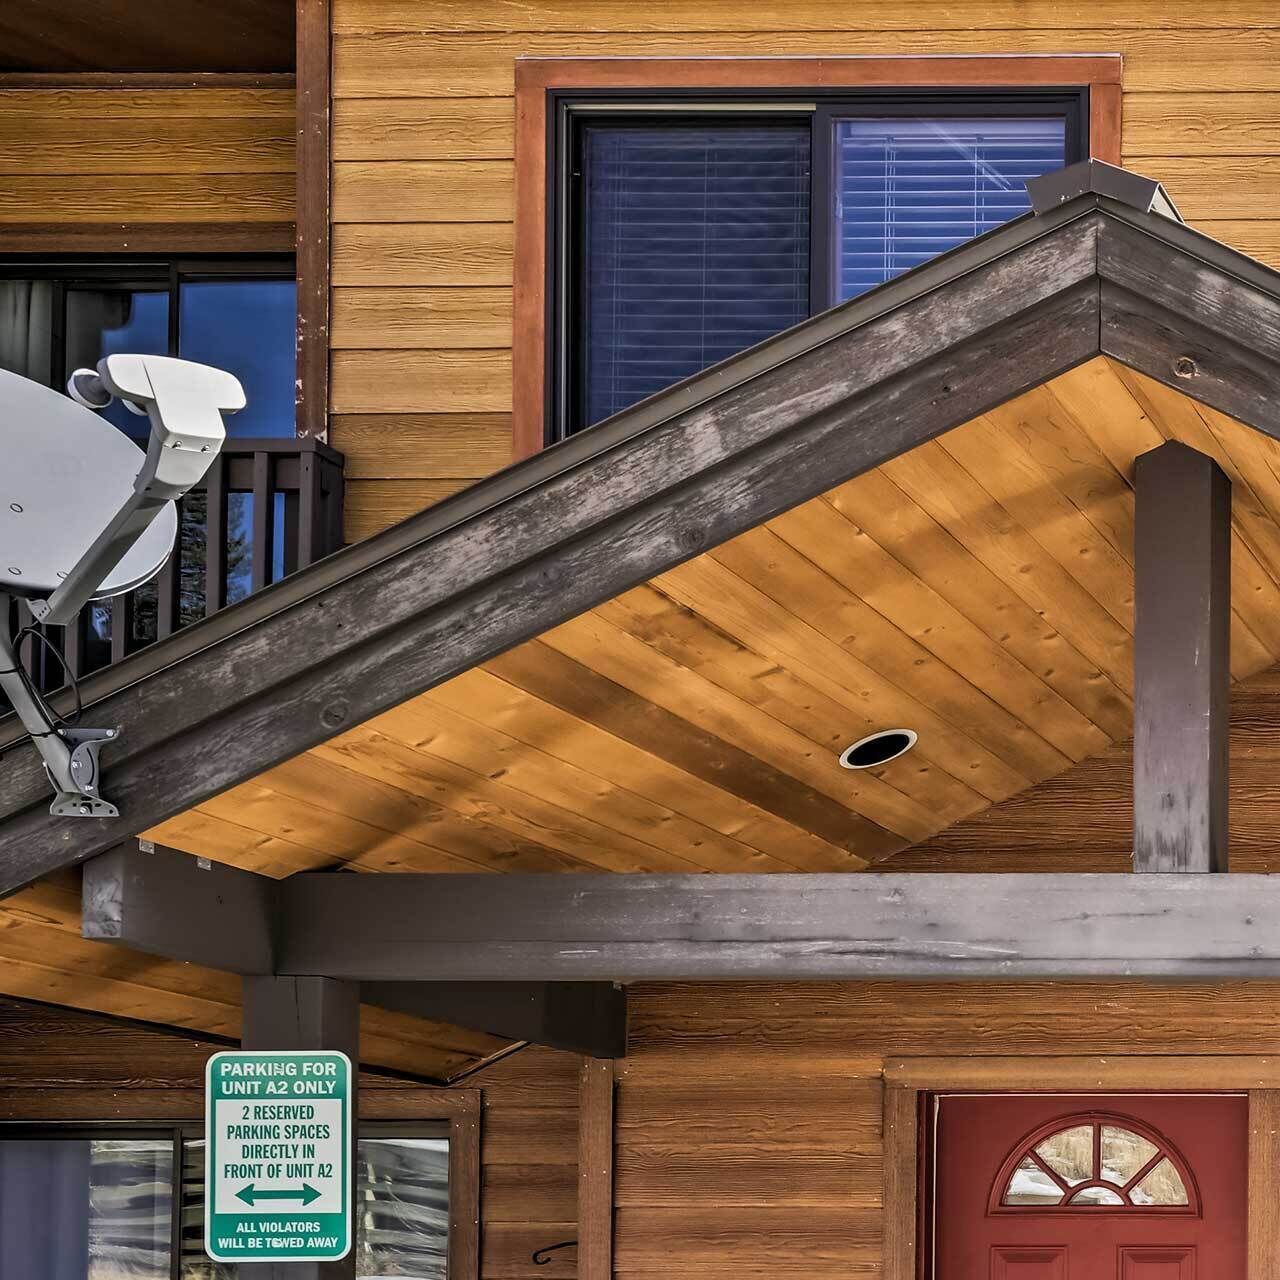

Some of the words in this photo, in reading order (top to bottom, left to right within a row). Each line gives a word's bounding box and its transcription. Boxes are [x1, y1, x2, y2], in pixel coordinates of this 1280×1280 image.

[221, 1063, 297, 1076] PARKING
[303, 1063, 336, 1075] FOR
[222, 1081, 261, 1094] UNIT
[266, 1081, 288, 1094] A2
[294, 1081, 336, 1094] ONLY
[242, 1106, 249, 1120] 2
[254, 1106, 314, 1120] RESERVED
[227, 1125, 280, 1139] PARKING
[285, 1125, 330, 1139] SPACES
[242, 1145, 299, 1159] DIRECTLY
[303, 1144, 315, 1158] IN
[224, 1164, 263, 1178] FRONT
[267, 1164, 282, 1178] OF
[286, 1164, 314, 1178] UNIT
[318, 1164, 332, 1177] A2
[236, 1223, 256, 1232] ALL
[259, 1222, 320, 1232] VIOLATORS
[218, 1238, 244, 1248] WILL
[248, 1238, 263, 1248] BE
[265, 1238, 304, 1248] TOWED
[307, 1238, 338, 1247] AWAY
